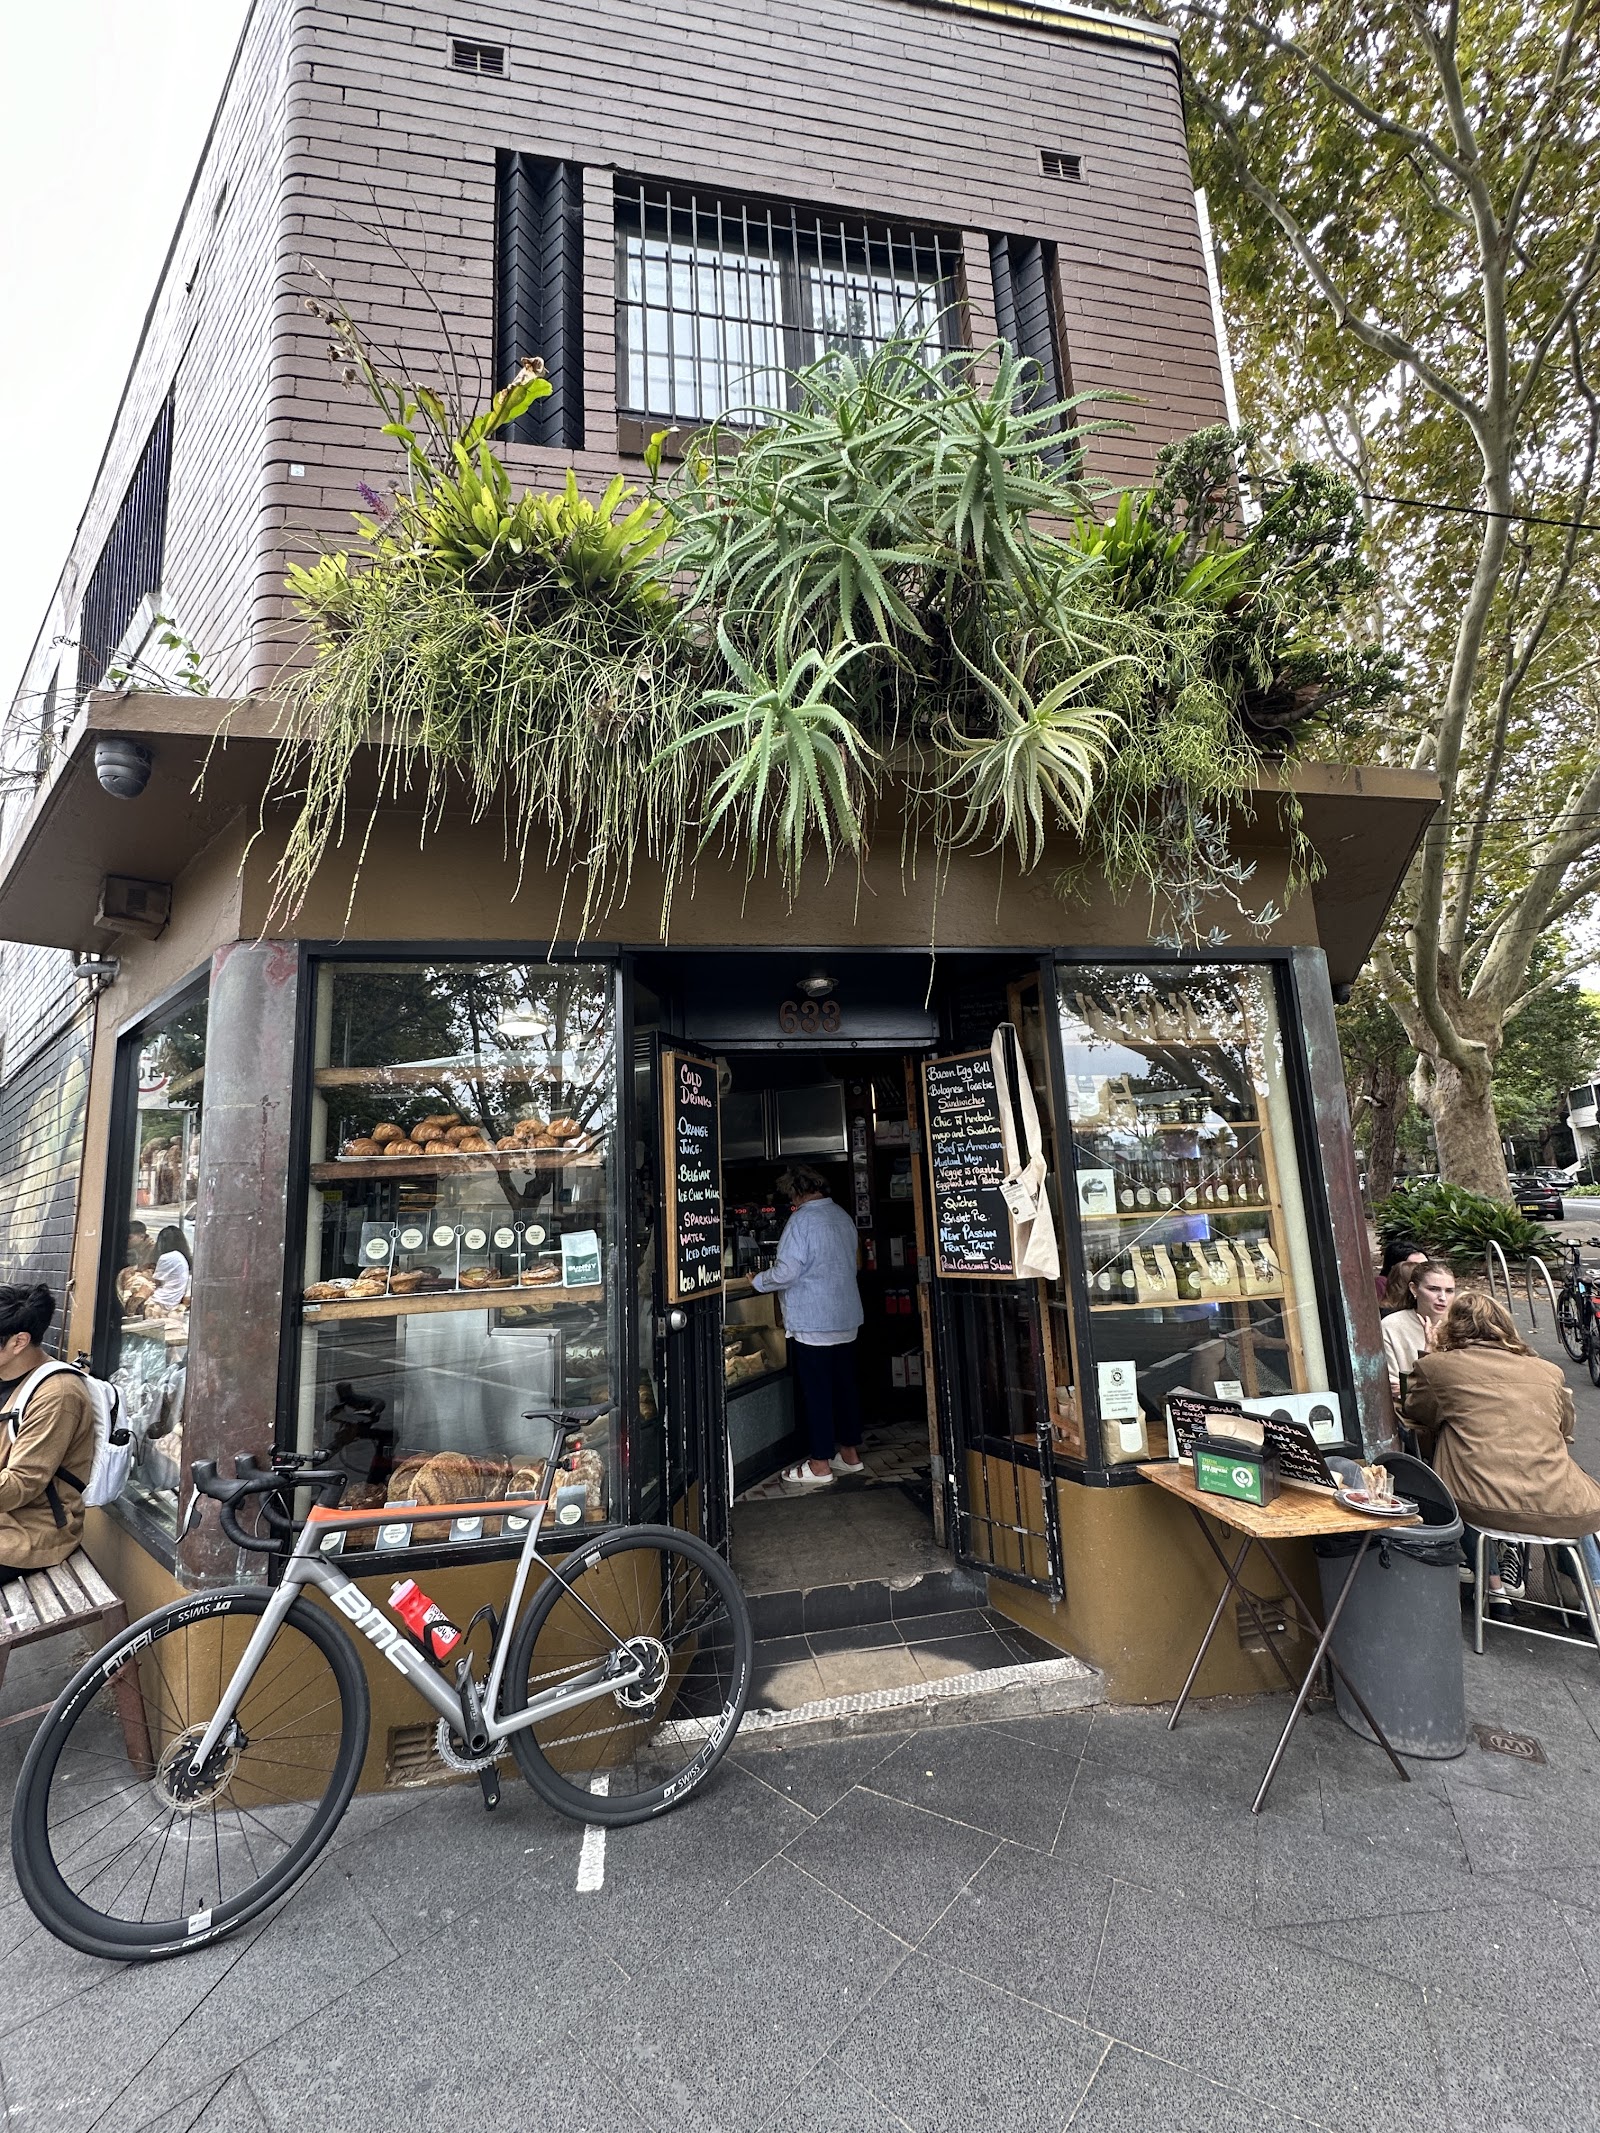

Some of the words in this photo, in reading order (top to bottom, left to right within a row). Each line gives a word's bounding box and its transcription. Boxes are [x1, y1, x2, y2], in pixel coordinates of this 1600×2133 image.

[780, 1001, 840, 1034] 633
[927, 1066, 956, 1081] Bacon
[956, 1064, 973, 1080] Egg
[973, 1061, 991, 1074] Roll
[962, 1078, 995, 1092] Toastie
[933, 1115, 953, 1128] Chic
[952, 1127, 966, 1138] and
[936, 1141, 956, 1155] Beef
[965, 1139, 1005, 1152] American
[940, 1166, 963, 1180] Veggie
[964, 1175, 978, 1186] and
[943, 1195, 978, 1211] Quiches
[1175, 1399, 1207, 1412] Veggie
[177, 1604, 210, 1623] SWISS
[212, 1600, 233, 1612] DT
[329, 1582, 425, 1675] BMC
[663, 1783, 677, 1799] DT
[678, 1763, 701, 1788] SWISS
